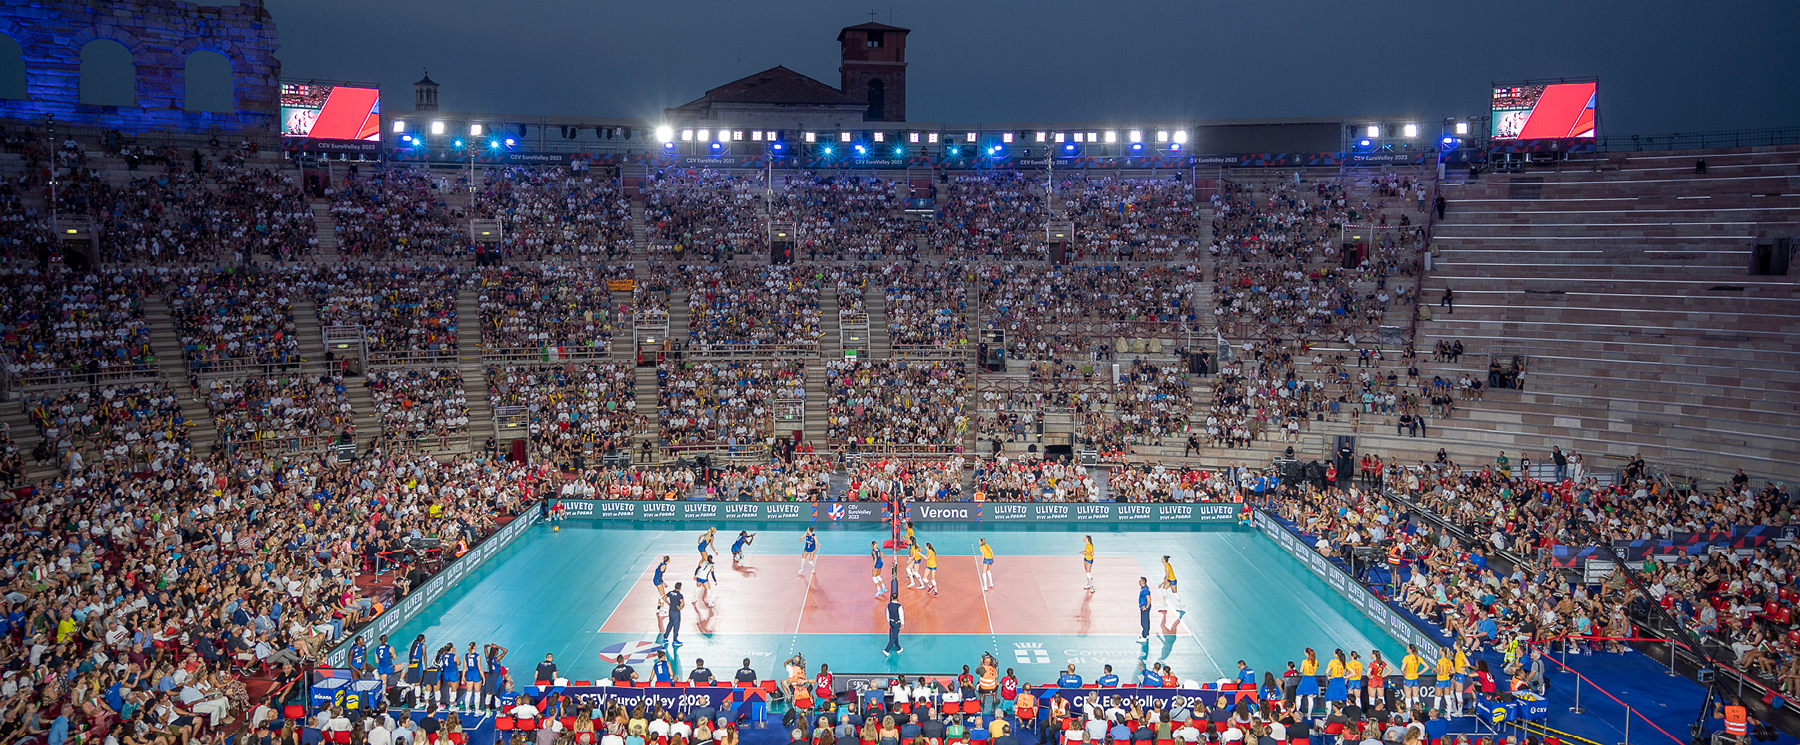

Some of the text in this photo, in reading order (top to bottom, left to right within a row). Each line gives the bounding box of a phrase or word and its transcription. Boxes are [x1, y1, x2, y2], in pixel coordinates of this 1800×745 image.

[332, 142, 360, 150] EuroVolley
[602, 503, 634, 511] ULIVETO
[643, 504, 675, 512] ULIVETO
[684, 504, 716, 512] ULIVETO
[726, 504, 758, 512] ULIVETO
[767, 505, 799, 513] ULIVETO
[994, 505, 1027, 514] ULIVETO
[1036, 506, 1068, 514] ULIVETO
[1077, 506, 1109, 514] ULIVETO
[1118, 506, 1150, 514] ULIVETO
[1160, 506, 1192, 514] ULIVETO
[1201, 506, 1233, 514] ULIVETO
[920, 506, 968, 518] Verona
[379, 608, 401, 632] ULIVETO
[1391, 615, 1411, 638] ULIVETO
[1415, 634, 1438, 659] ULIVETO
[379, 649, 384, 658] 2
[1377, 668, 1382, 676] 2
[580, 694, 710, 709] CEV EuroVolley 2023
